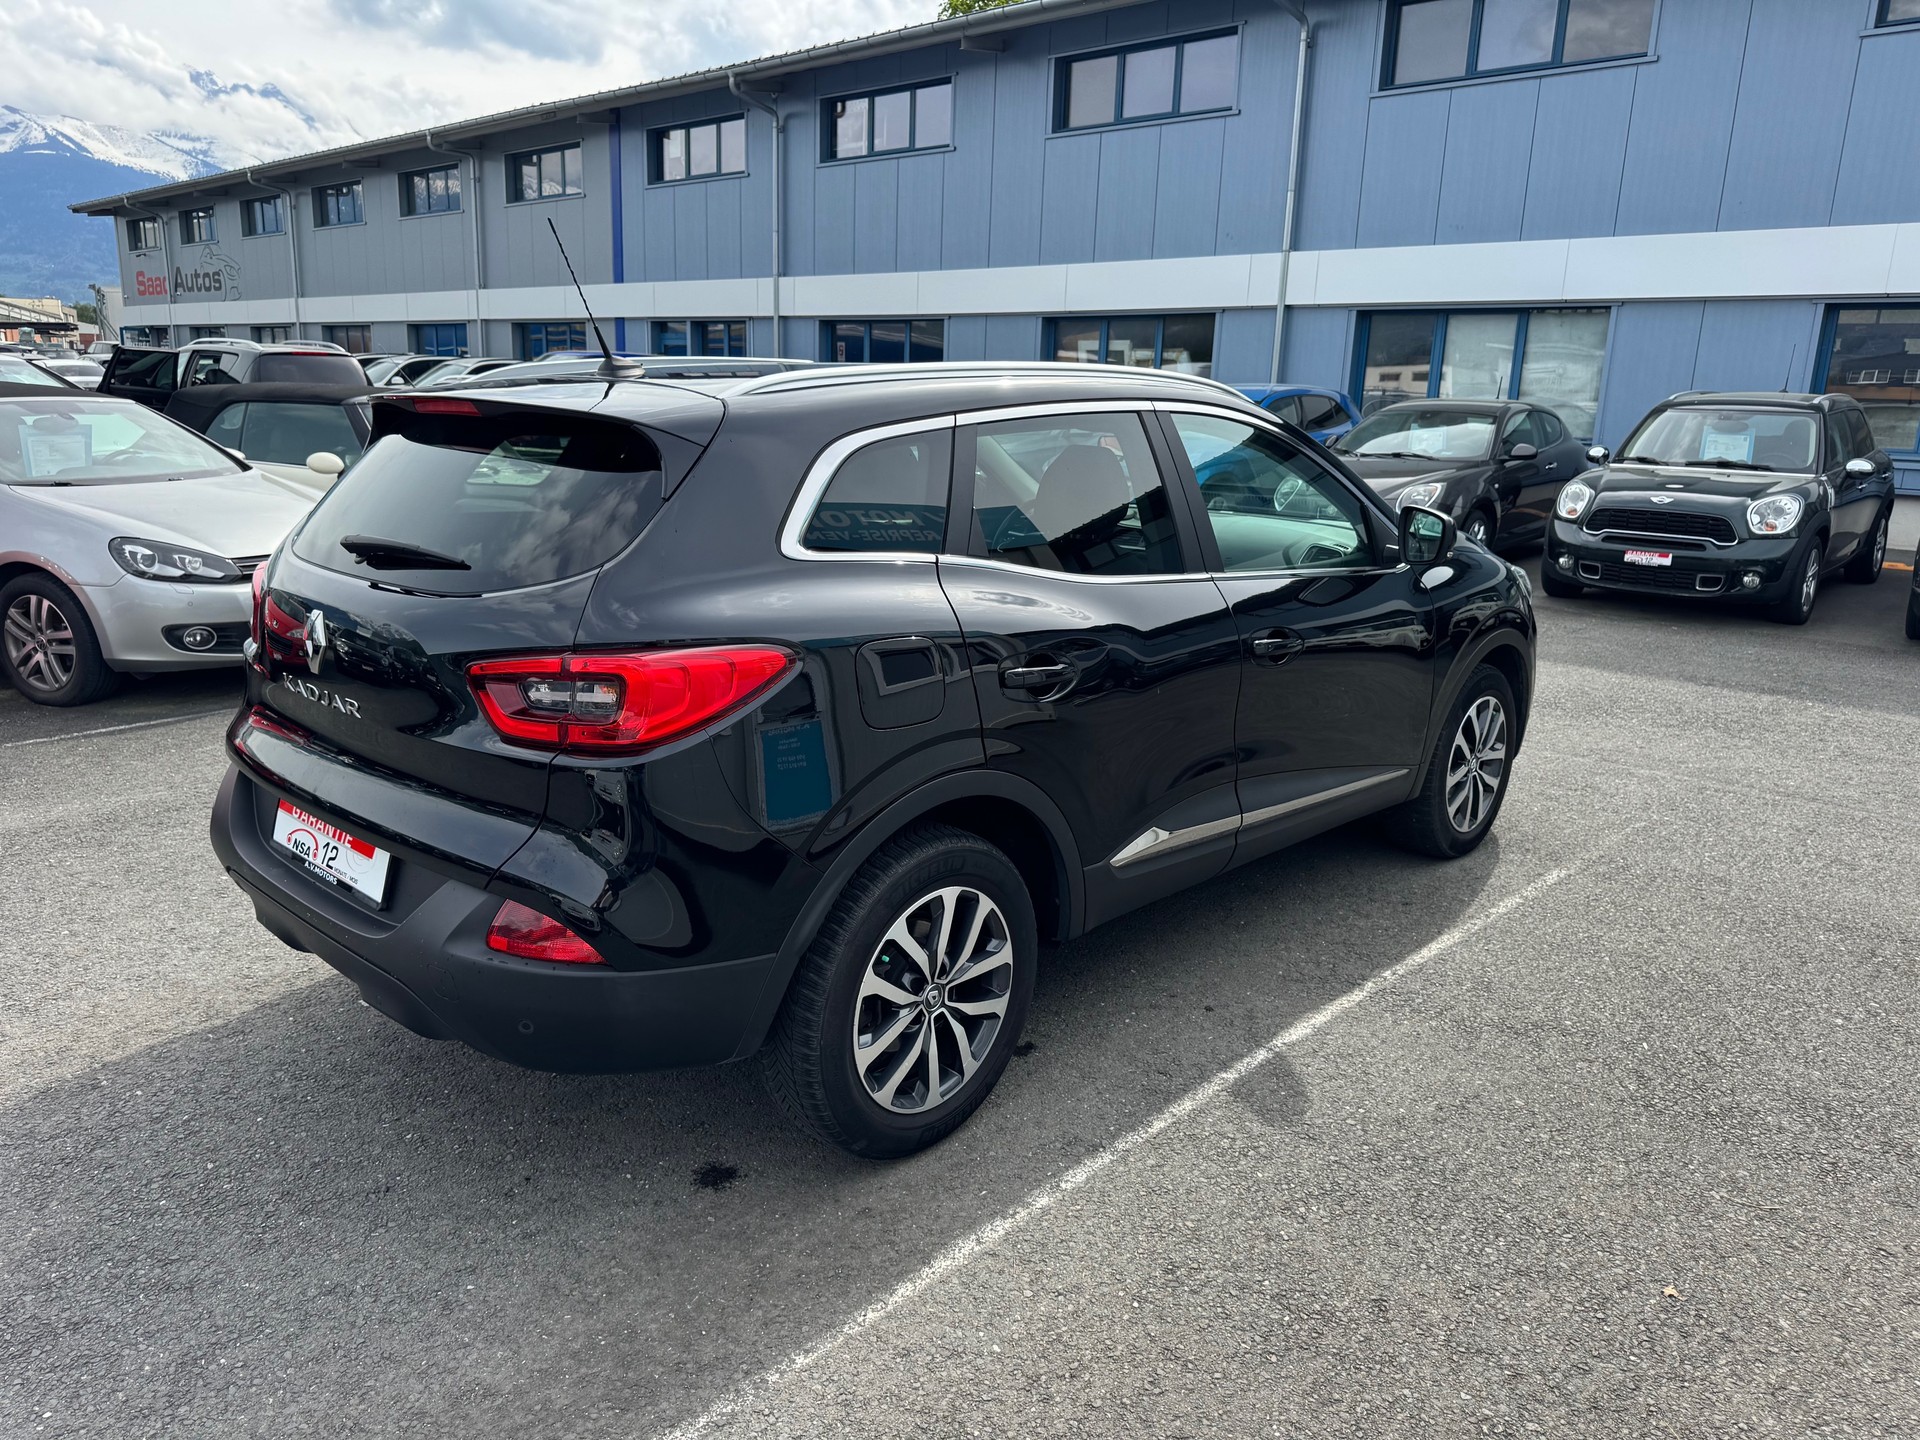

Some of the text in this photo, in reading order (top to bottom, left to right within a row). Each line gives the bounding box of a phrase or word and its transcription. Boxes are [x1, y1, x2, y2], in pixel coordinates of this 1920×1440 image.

[175, 266, 222, 293] Autos
[282, 672, 362, 719] KADJAR
[292, 806, 354, 849] GARANTIE
[292, 838, 312, 858] NSA
[321, 842, 340, 871] 12
